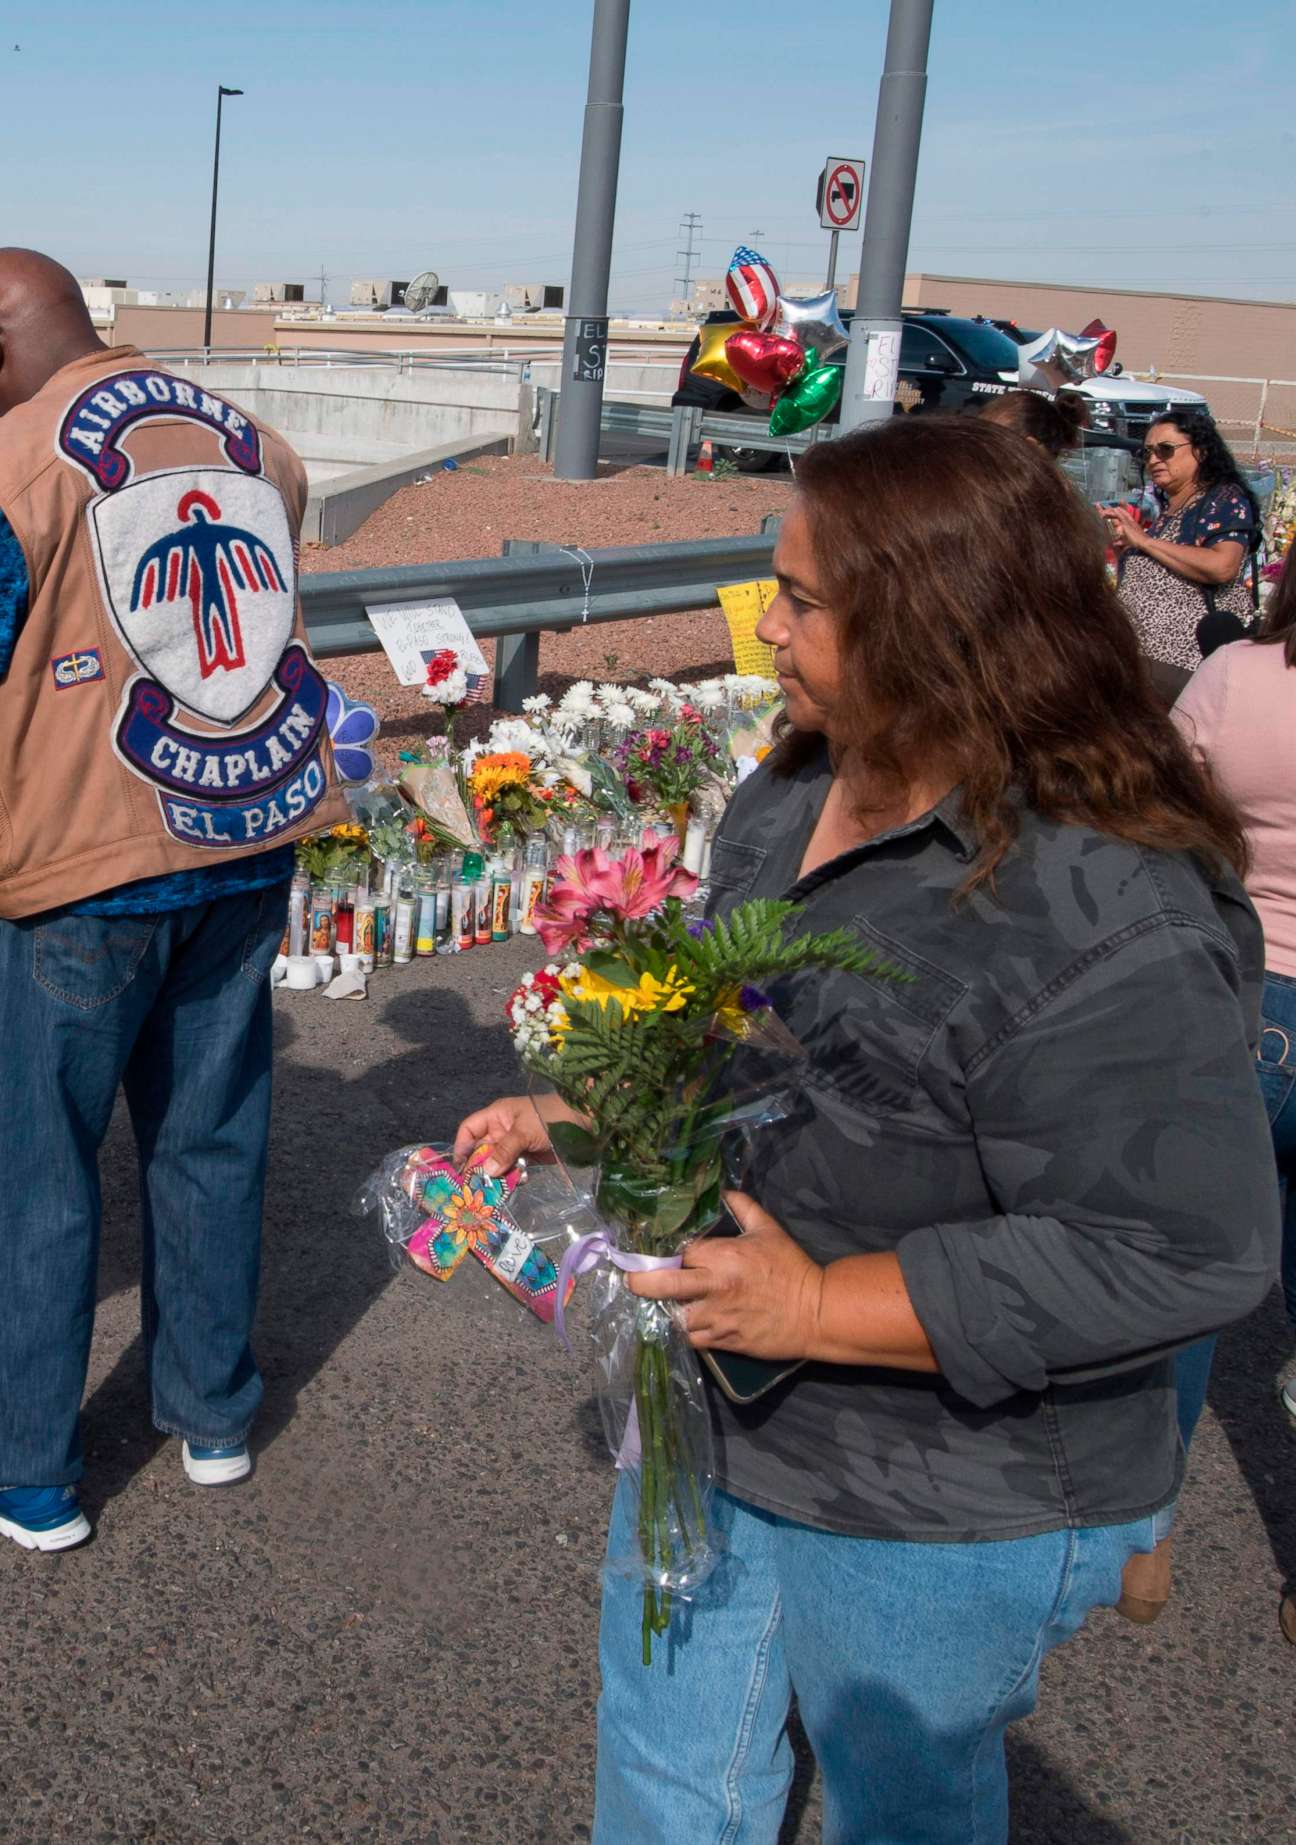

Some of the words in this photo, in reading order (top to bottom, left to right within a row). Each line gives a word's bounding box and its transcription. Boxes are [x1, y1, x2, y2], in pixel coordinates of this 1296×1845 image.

[584, 324, 604, 339] EL
[583, 344, 606, 368] S
[972, 382, 1006, 395] STATE
[69, 375, 249, 454] AIRBORNE
[151, 703, 316, 788] CHAPLAIN
[167, 800, 232, 843] EL
[244, 762, 325, 840] PASO
[499, 1238, 528, 1273] love
